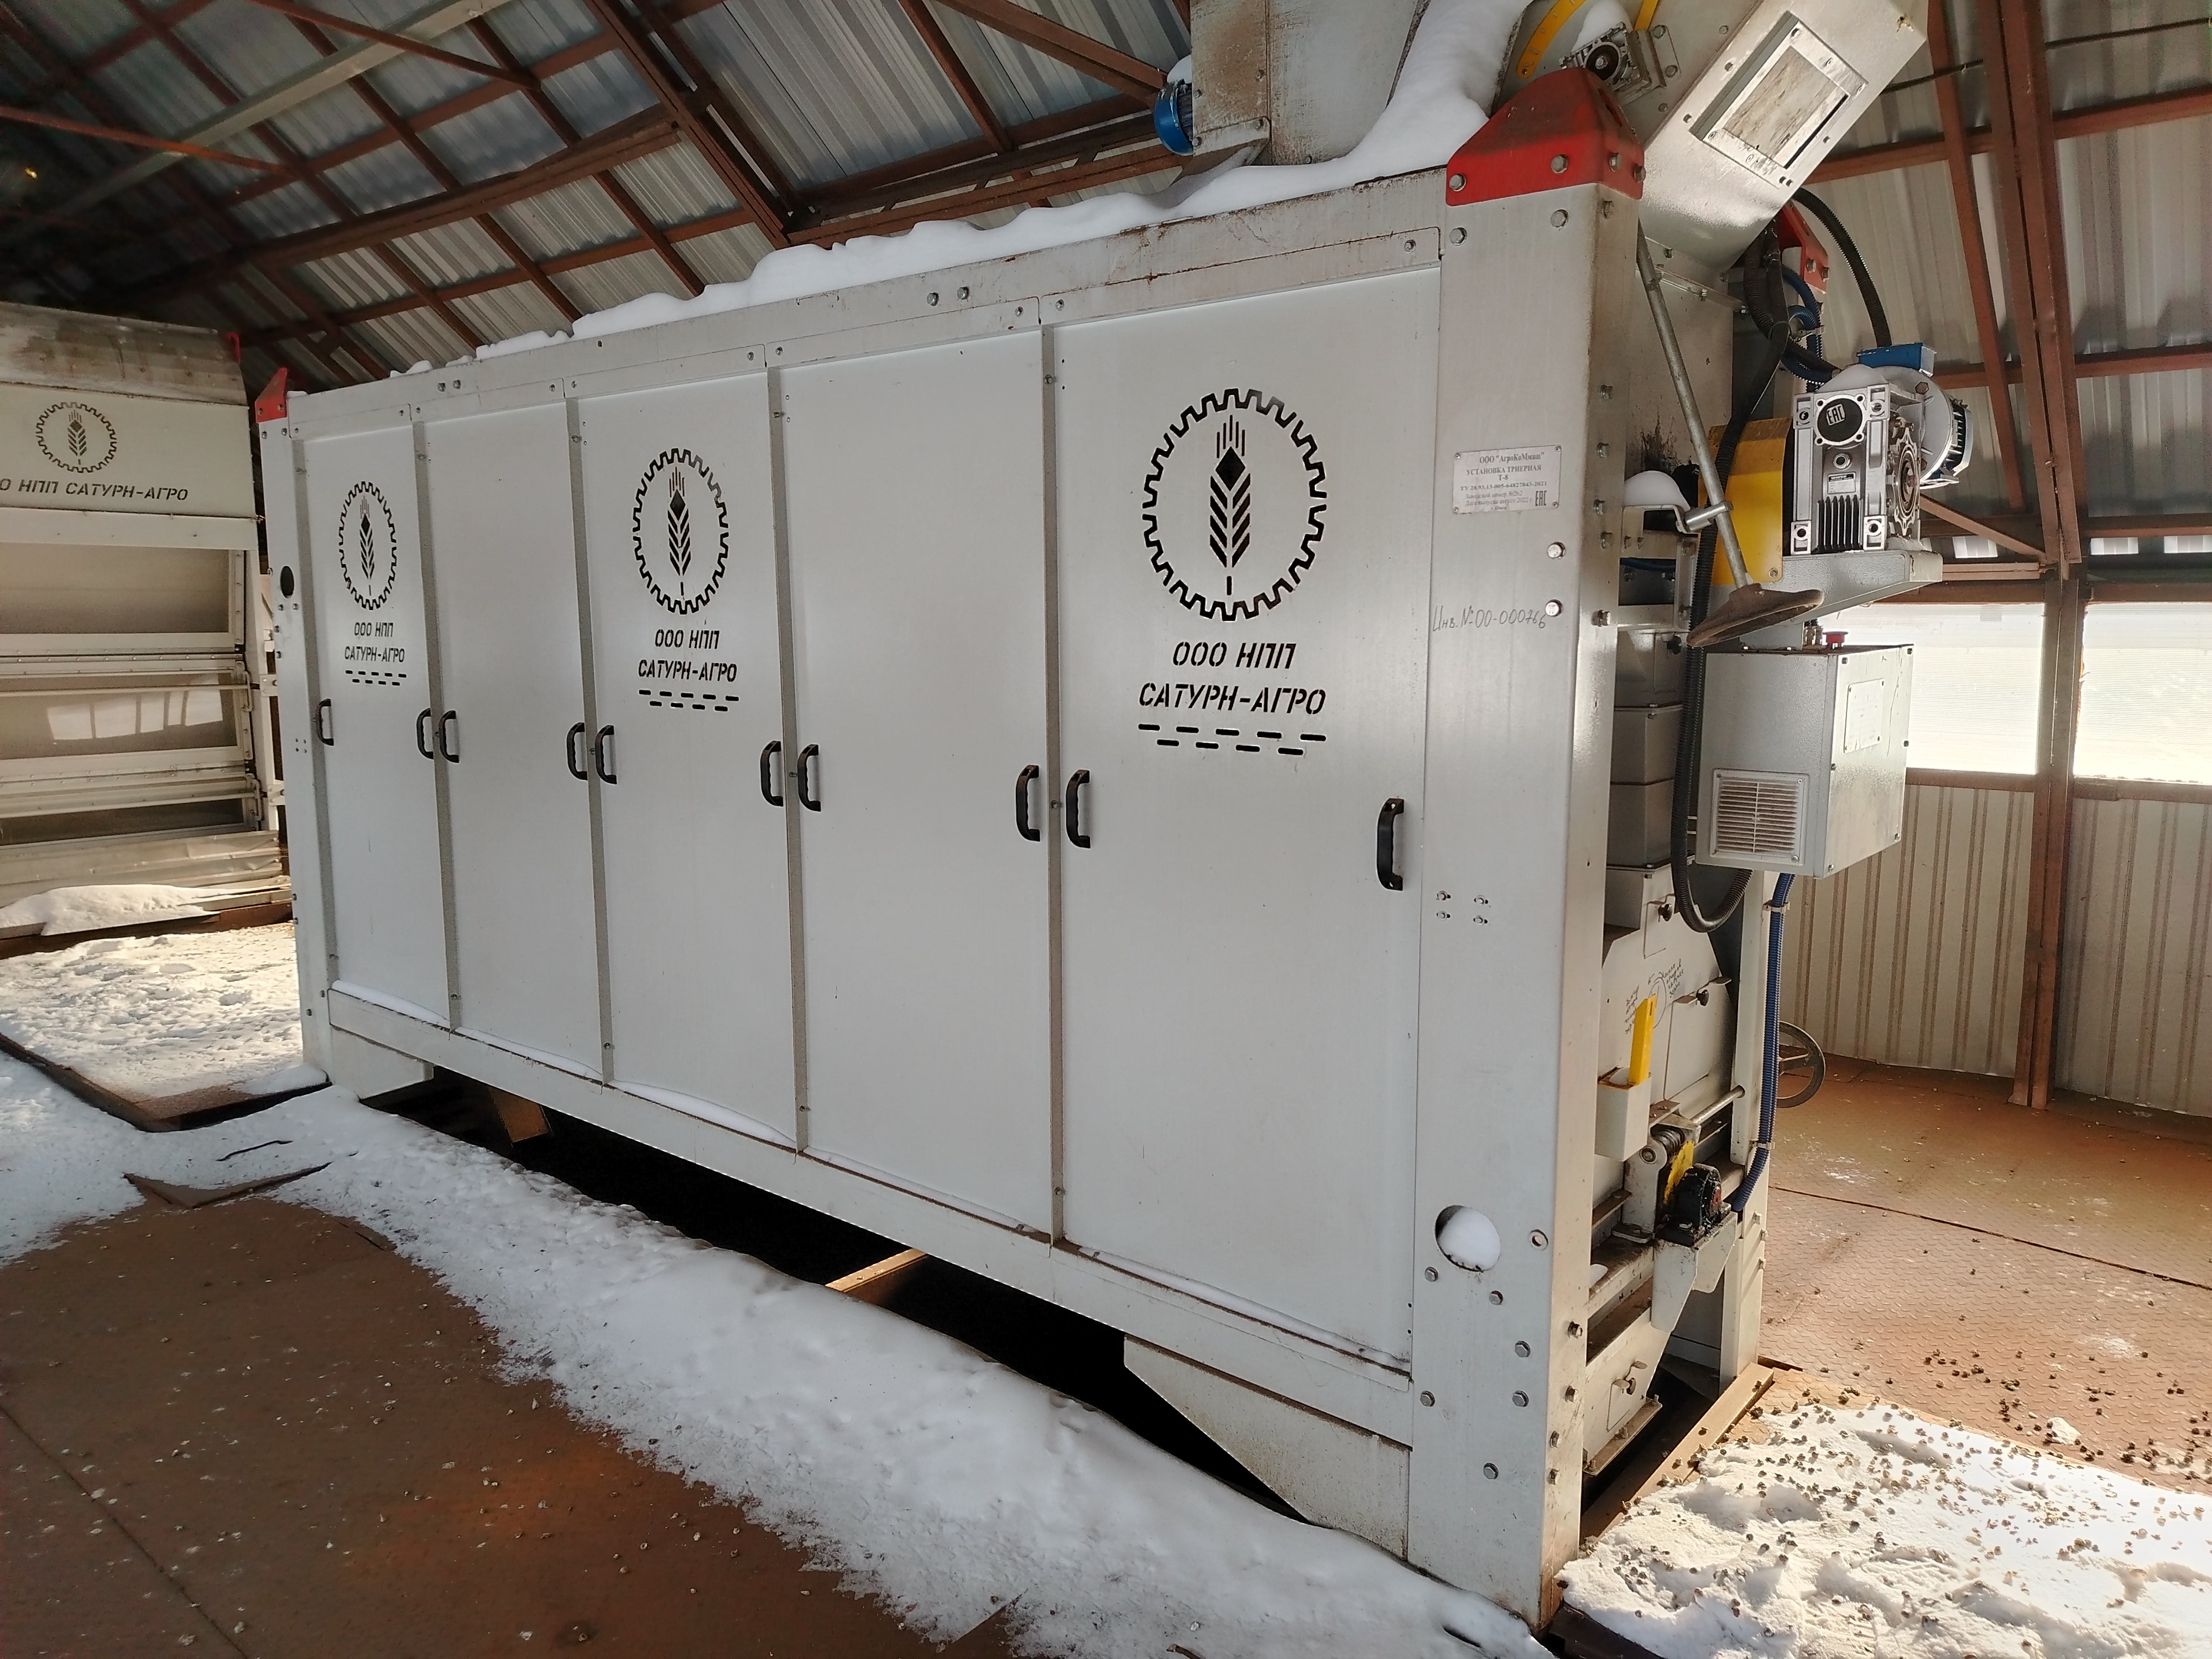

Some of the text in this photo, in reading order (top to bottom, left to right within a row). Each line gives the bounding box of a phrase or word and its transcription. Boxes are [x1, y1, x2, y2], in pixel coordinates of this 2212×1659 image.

[1479, 455, 1495, 463] ООО
[1467, 465, 1542, 476] УСТАНОВКА ТРИЕРНАЯ
[18, 479, 59, 493] НПП
[65, 481, 189, 501] САТУРН-АГРО
[354, 622, 394, 637] ООО НПП
[655, 629, 720, 649] ООО НПП
[344, 645, 405, 662] САТУРН-АГРО
[1172, 641, 1297, 669] ООО НПП
[638, 659, 737, 682] САТУРН-АГРО
[1139, 682, 1326, 715] САТУРН-АГРО
